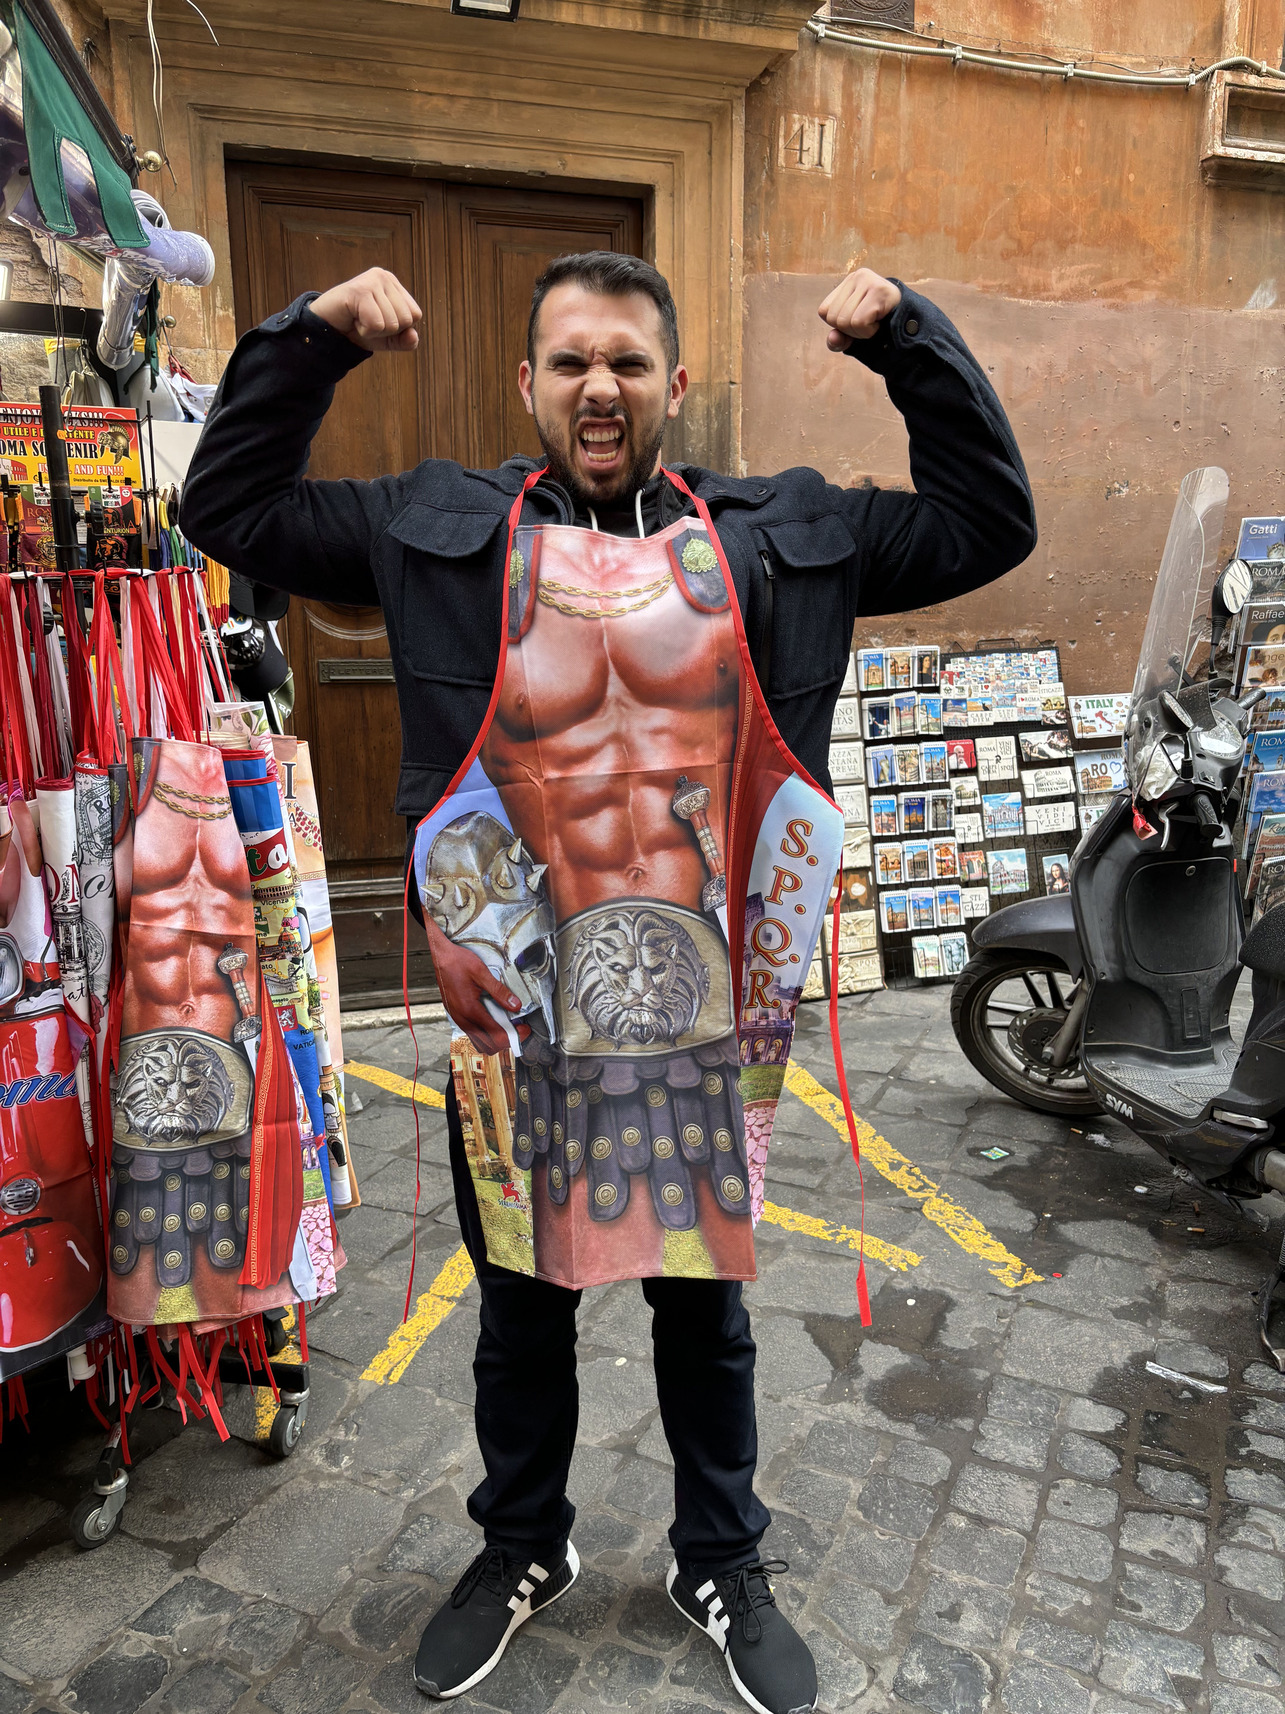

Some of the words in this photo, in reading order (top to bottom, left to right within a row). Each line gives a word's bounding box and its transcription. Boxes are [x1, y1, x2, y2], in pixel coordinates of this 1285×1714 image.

[784, 123, 826, 167] 41
[0, 407, 41, 426] ENJOY
[3, 426, 30, 436] UTILE
[32, 428, 39, 437] E
[0, 439, 27, 456] OMA
[32, 441, 98, 459] SOENIR
[74, 464, 94, 475] AND
[96, 465, 125, 476] FUN!!!
[1249, 523, 1278, 535] Gatti
[1251, 609, 1285, 620] Raffae
[1085, 698, 1114, 709] ITALY
[834, 707, 852, 716] INO
[1261, 737, 1285, 747] ROM
[831, 750, 851, 758] AZZA
[1263, 778, 1285, 788] ROM
[1267, 864, 1284, 875] RO
[260, 898, 289, 906] Vicenza
[965, 903, 986, 911] CAZZ
[293, 1039, 315, 1050] VATICA
[1105, 1093, 1134, 1120] SYM
